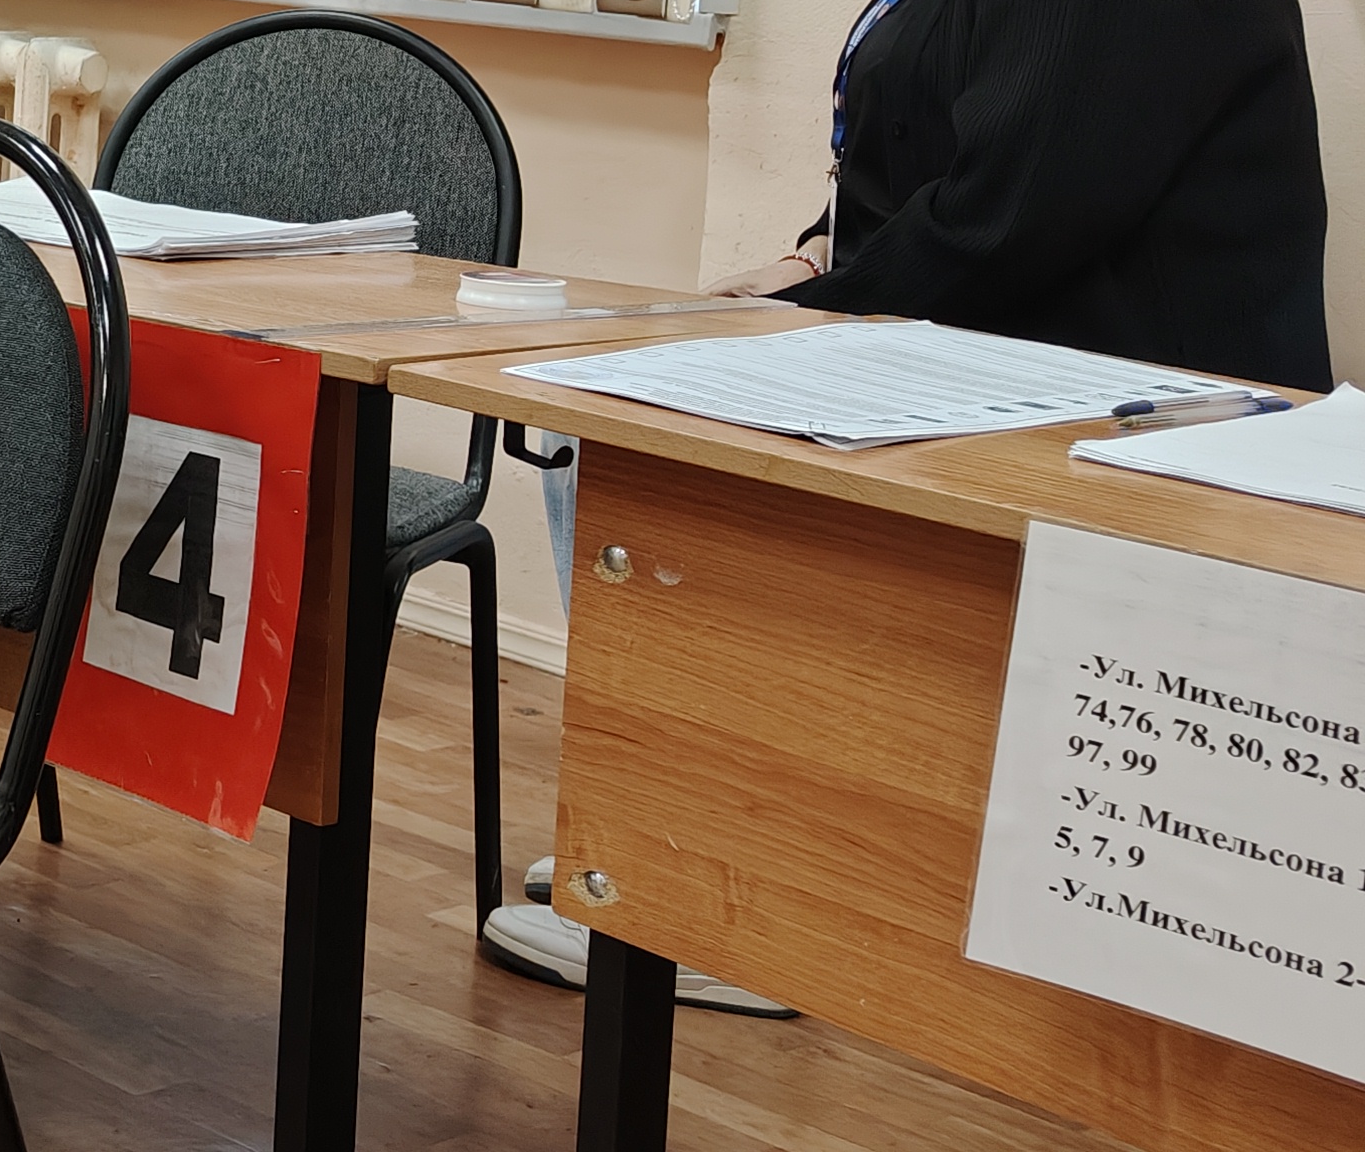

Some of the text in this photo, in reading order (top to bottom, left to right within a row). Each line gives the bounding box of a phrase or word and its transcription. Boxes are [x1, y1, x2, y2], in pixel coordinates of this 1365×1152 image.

[115, 450, 225, 680] 4
[1073, 693, 1162, 742] 74,76,
[1172, 718, 1217, 756] 78,
[1226, 732, 1272, 771] 80,
[1282, 747, 1329, 787] 82,
[1079, 653, 1362, 745] -Ул. Михельсона
[1066, 735, 1158, 777] 97, 99
[1053, 824, 1146, 868] 5, 7, 9
[1060, 785, 1127, 822] -Ул.
[1136, 802, 1346, 886] Михельсона
